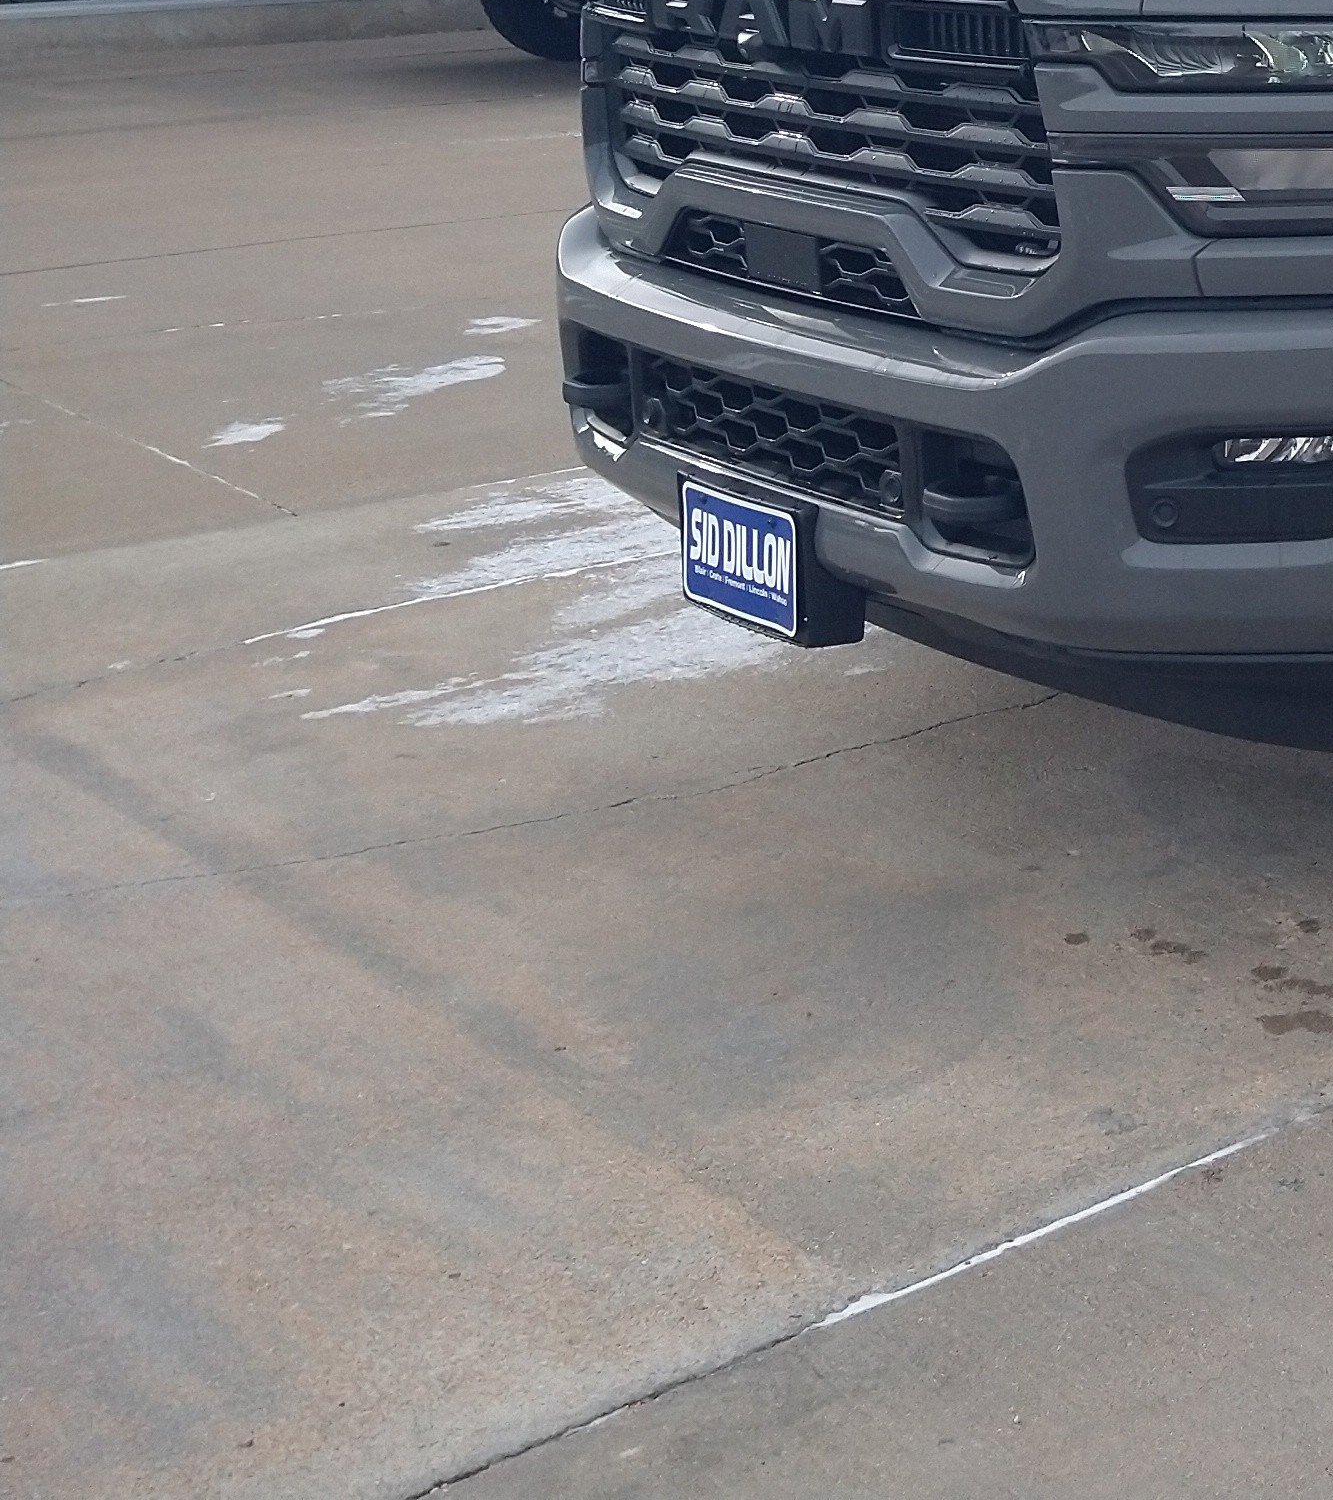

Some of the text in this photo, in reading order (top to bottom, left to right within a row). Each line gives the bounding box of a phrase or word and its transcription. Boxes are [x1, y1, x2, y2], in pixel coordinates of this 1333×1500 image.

[689, 507, 791, 595] SID DILLON
[724, 576, 746, 591] Fremont
[748, 584, 768, 598] Lincoln
